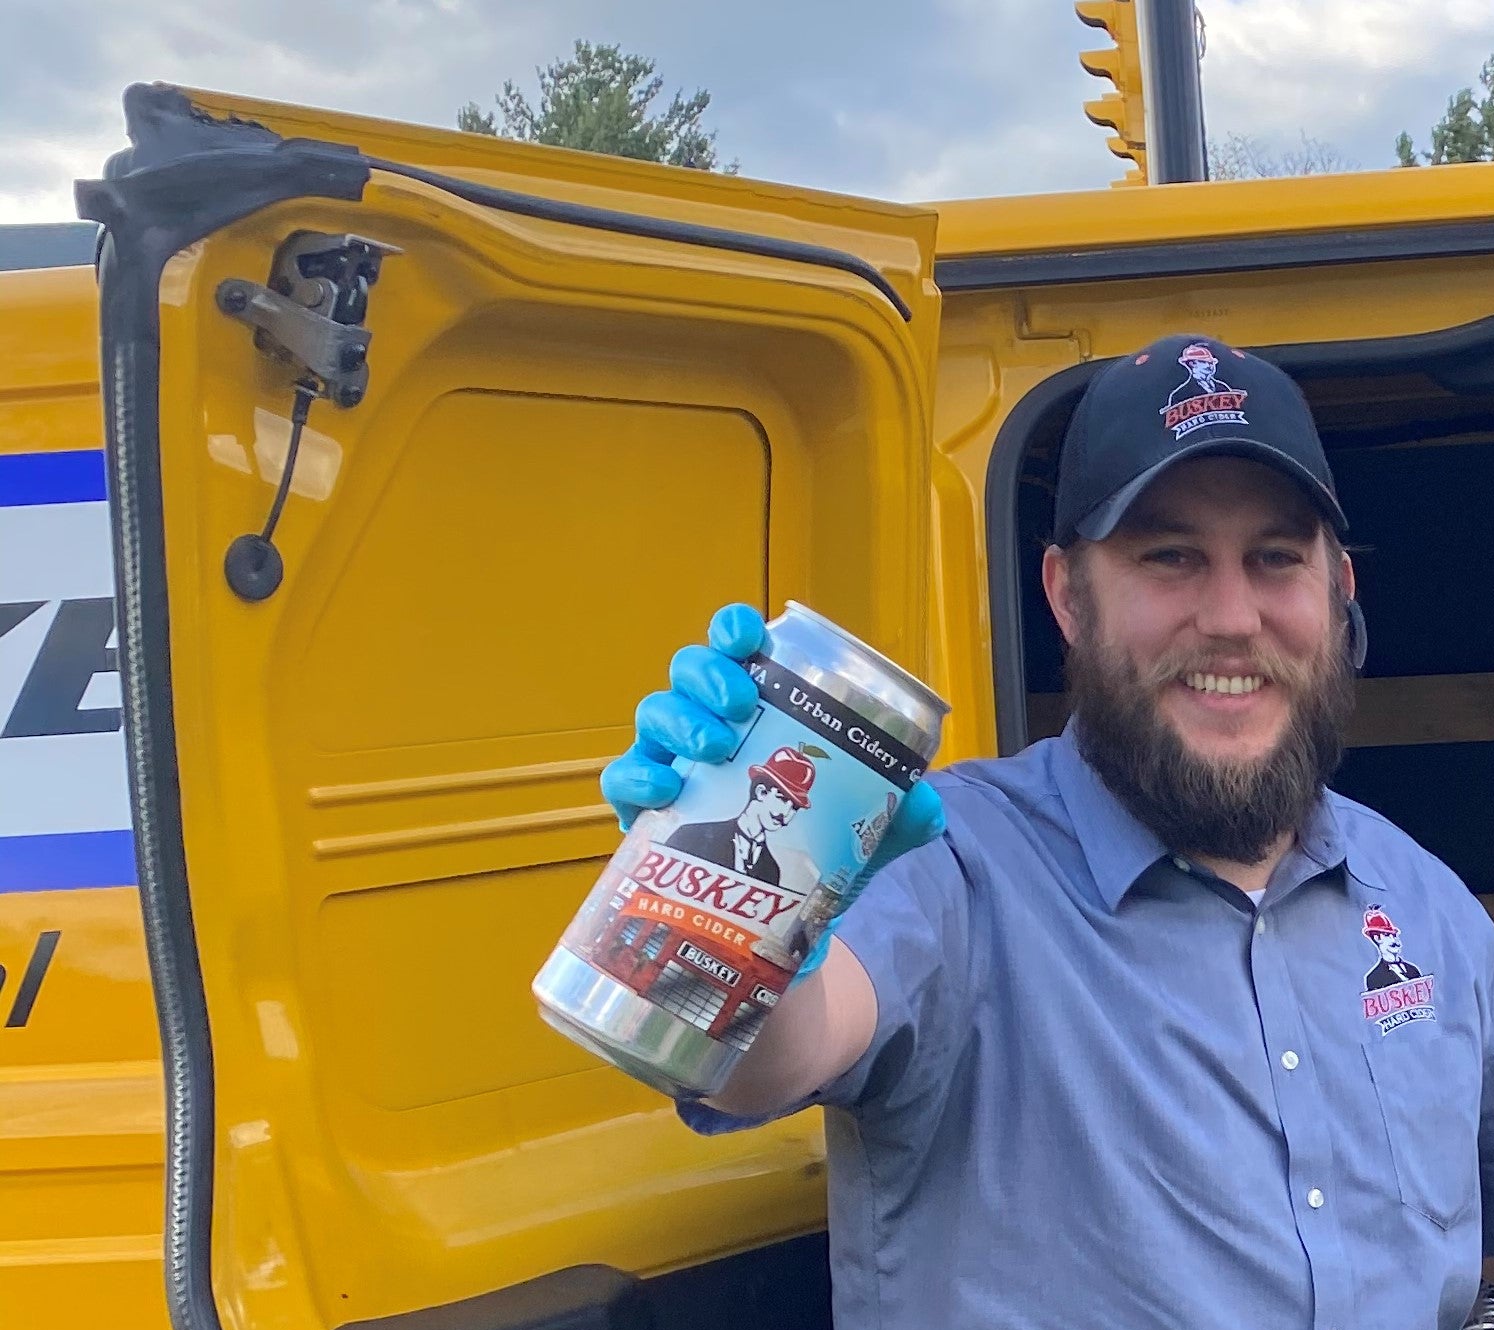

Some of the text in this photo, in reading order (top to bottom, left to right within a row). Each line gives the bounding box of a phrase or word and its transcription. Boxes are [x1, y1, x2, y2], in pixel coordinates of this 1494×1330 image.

[1165, 394, 1245, 428] BUSKEY
[788, 686, 844, 733] Urban
[846, 726, 899, 769] Cidery
[629, 850, 802, 926] BUSKEY
[637, 897, 746, 947] HARD CIDER
[684, 947, 736, 982] BUSKEY
[1362, 978, 1434, 1019] BUSKEY
[1381, 1010, 1411, 1031] HARD
